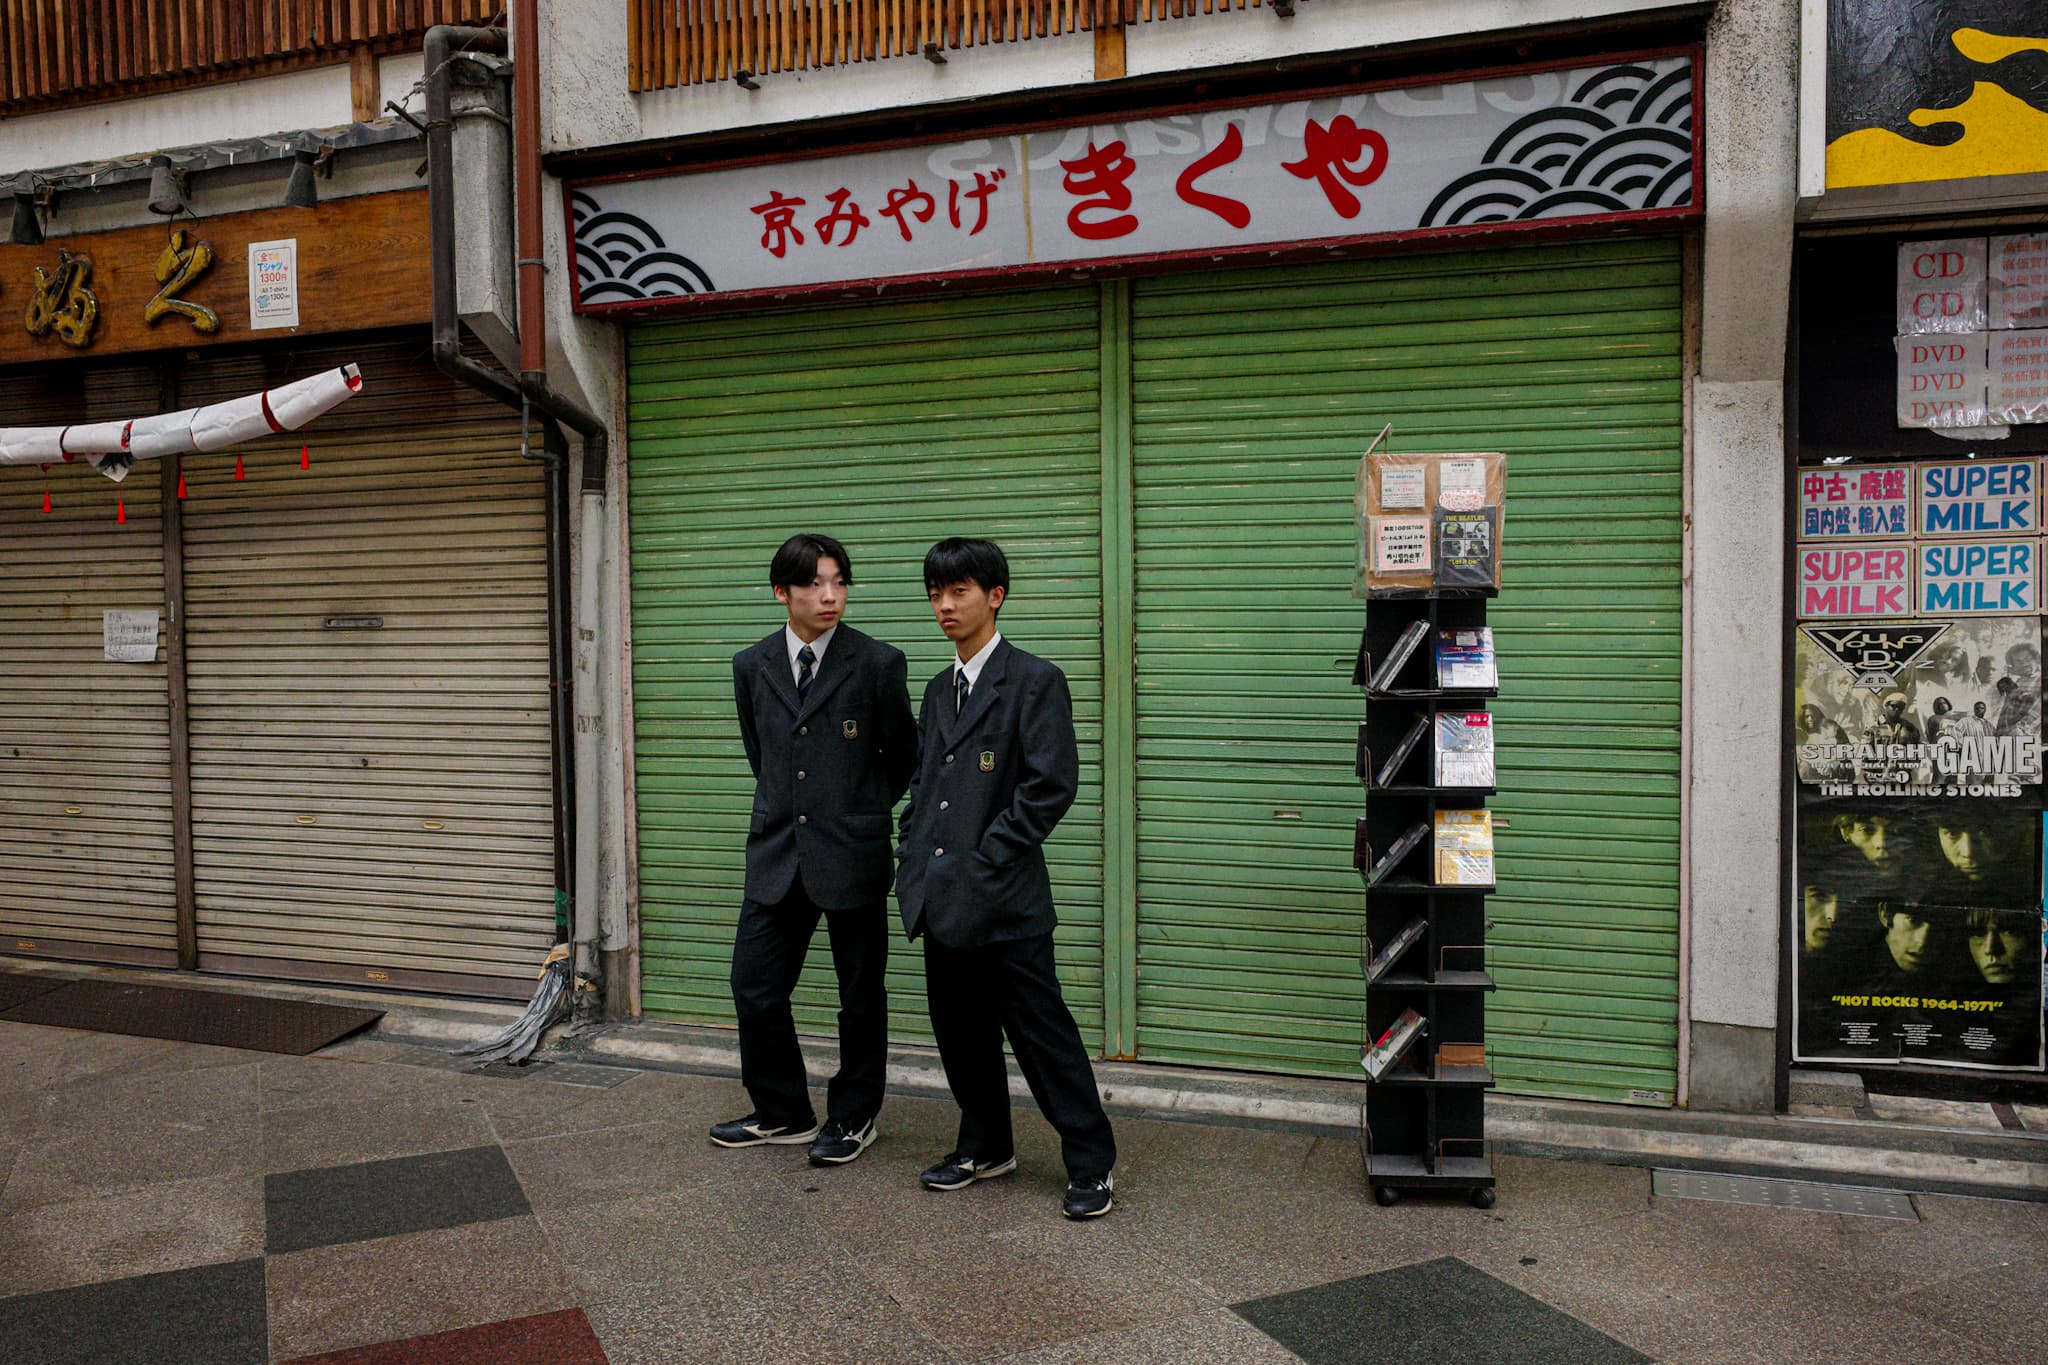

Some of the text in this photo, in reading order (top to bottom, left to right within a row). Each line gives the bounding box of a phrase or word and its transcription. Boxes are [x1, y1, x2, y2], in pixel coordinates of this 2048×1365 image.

[751, 114, 1389, 258] 京みやげ きくや
[257, 262, 283, 272] Tシャツ
[260, 271, 287, 283] 1300円
[1912, 252, 1965, 279] CD
[1912, 292, 1965, 319] CD
[1912, 344, 1966, 364] DVD
[1912, 372, 1965, 392] DVD
[1912, 401, 1966, 420] DVD
[1804, 469, 1906, 502] 中古・廃盤
[1925, 464, 2031, 498] SUPER
[1805, 505, 1905, 535] 国内盤・輸入盤
[1926, 500, 2030, 532] MILK
[1804, 550, 1905, 581] SUPER
[1925, 545, 2030, 576] SUPER
[1805, 585, 1904, 614] MILK
[1925, 580, 2029, 610] MILK
[1802, 736, 2036, 776] STRAIGHT GAME
[1819, 784, 2022, 797] THE ROLLING STONES
[1872, 996, 1919, 1008] ROCKS
